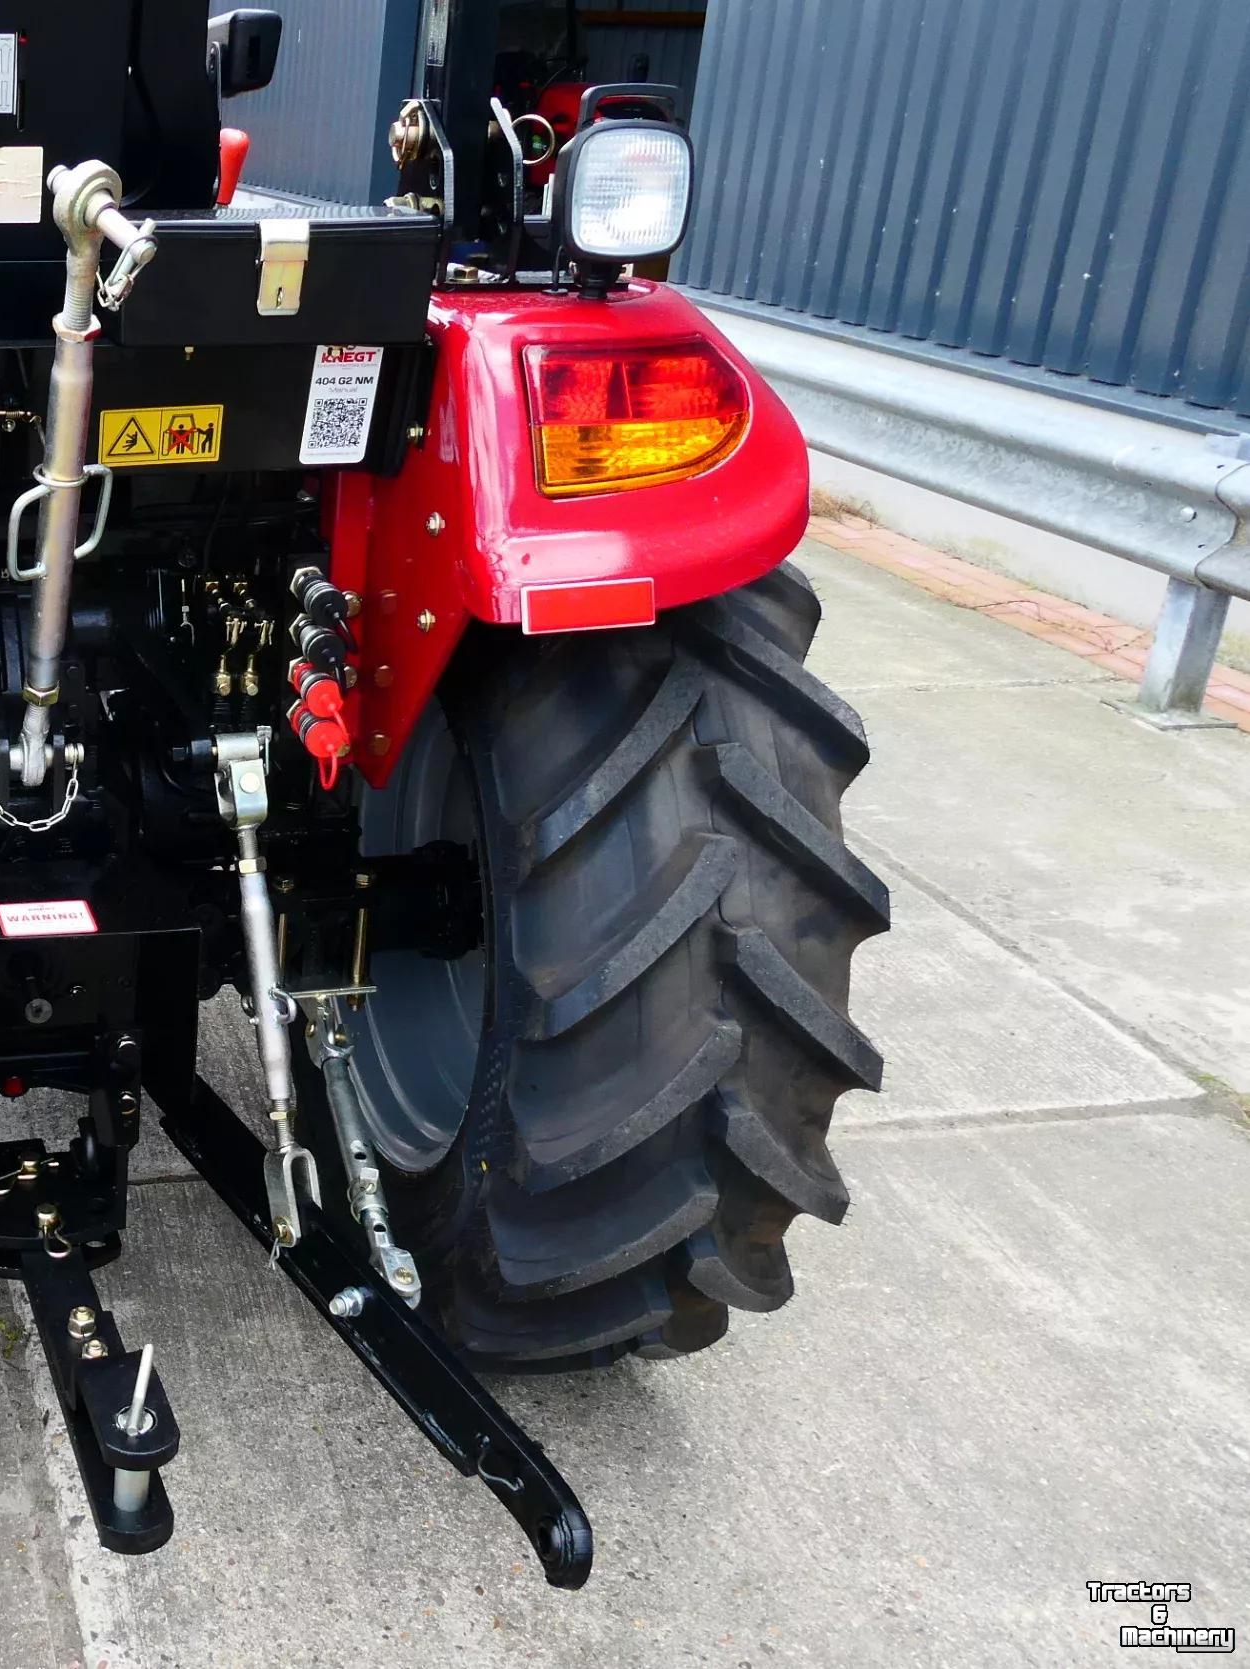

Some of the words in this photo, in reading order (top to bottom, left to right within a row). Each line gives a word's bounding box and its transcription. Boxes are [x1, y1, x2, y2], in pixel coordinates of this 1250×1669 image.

[315, 377, 336, 386] 404
[338, 376, 353, 386] G2
[354, 376, 375, 385] NM
[6, 912, 84, 922] WARNING!
